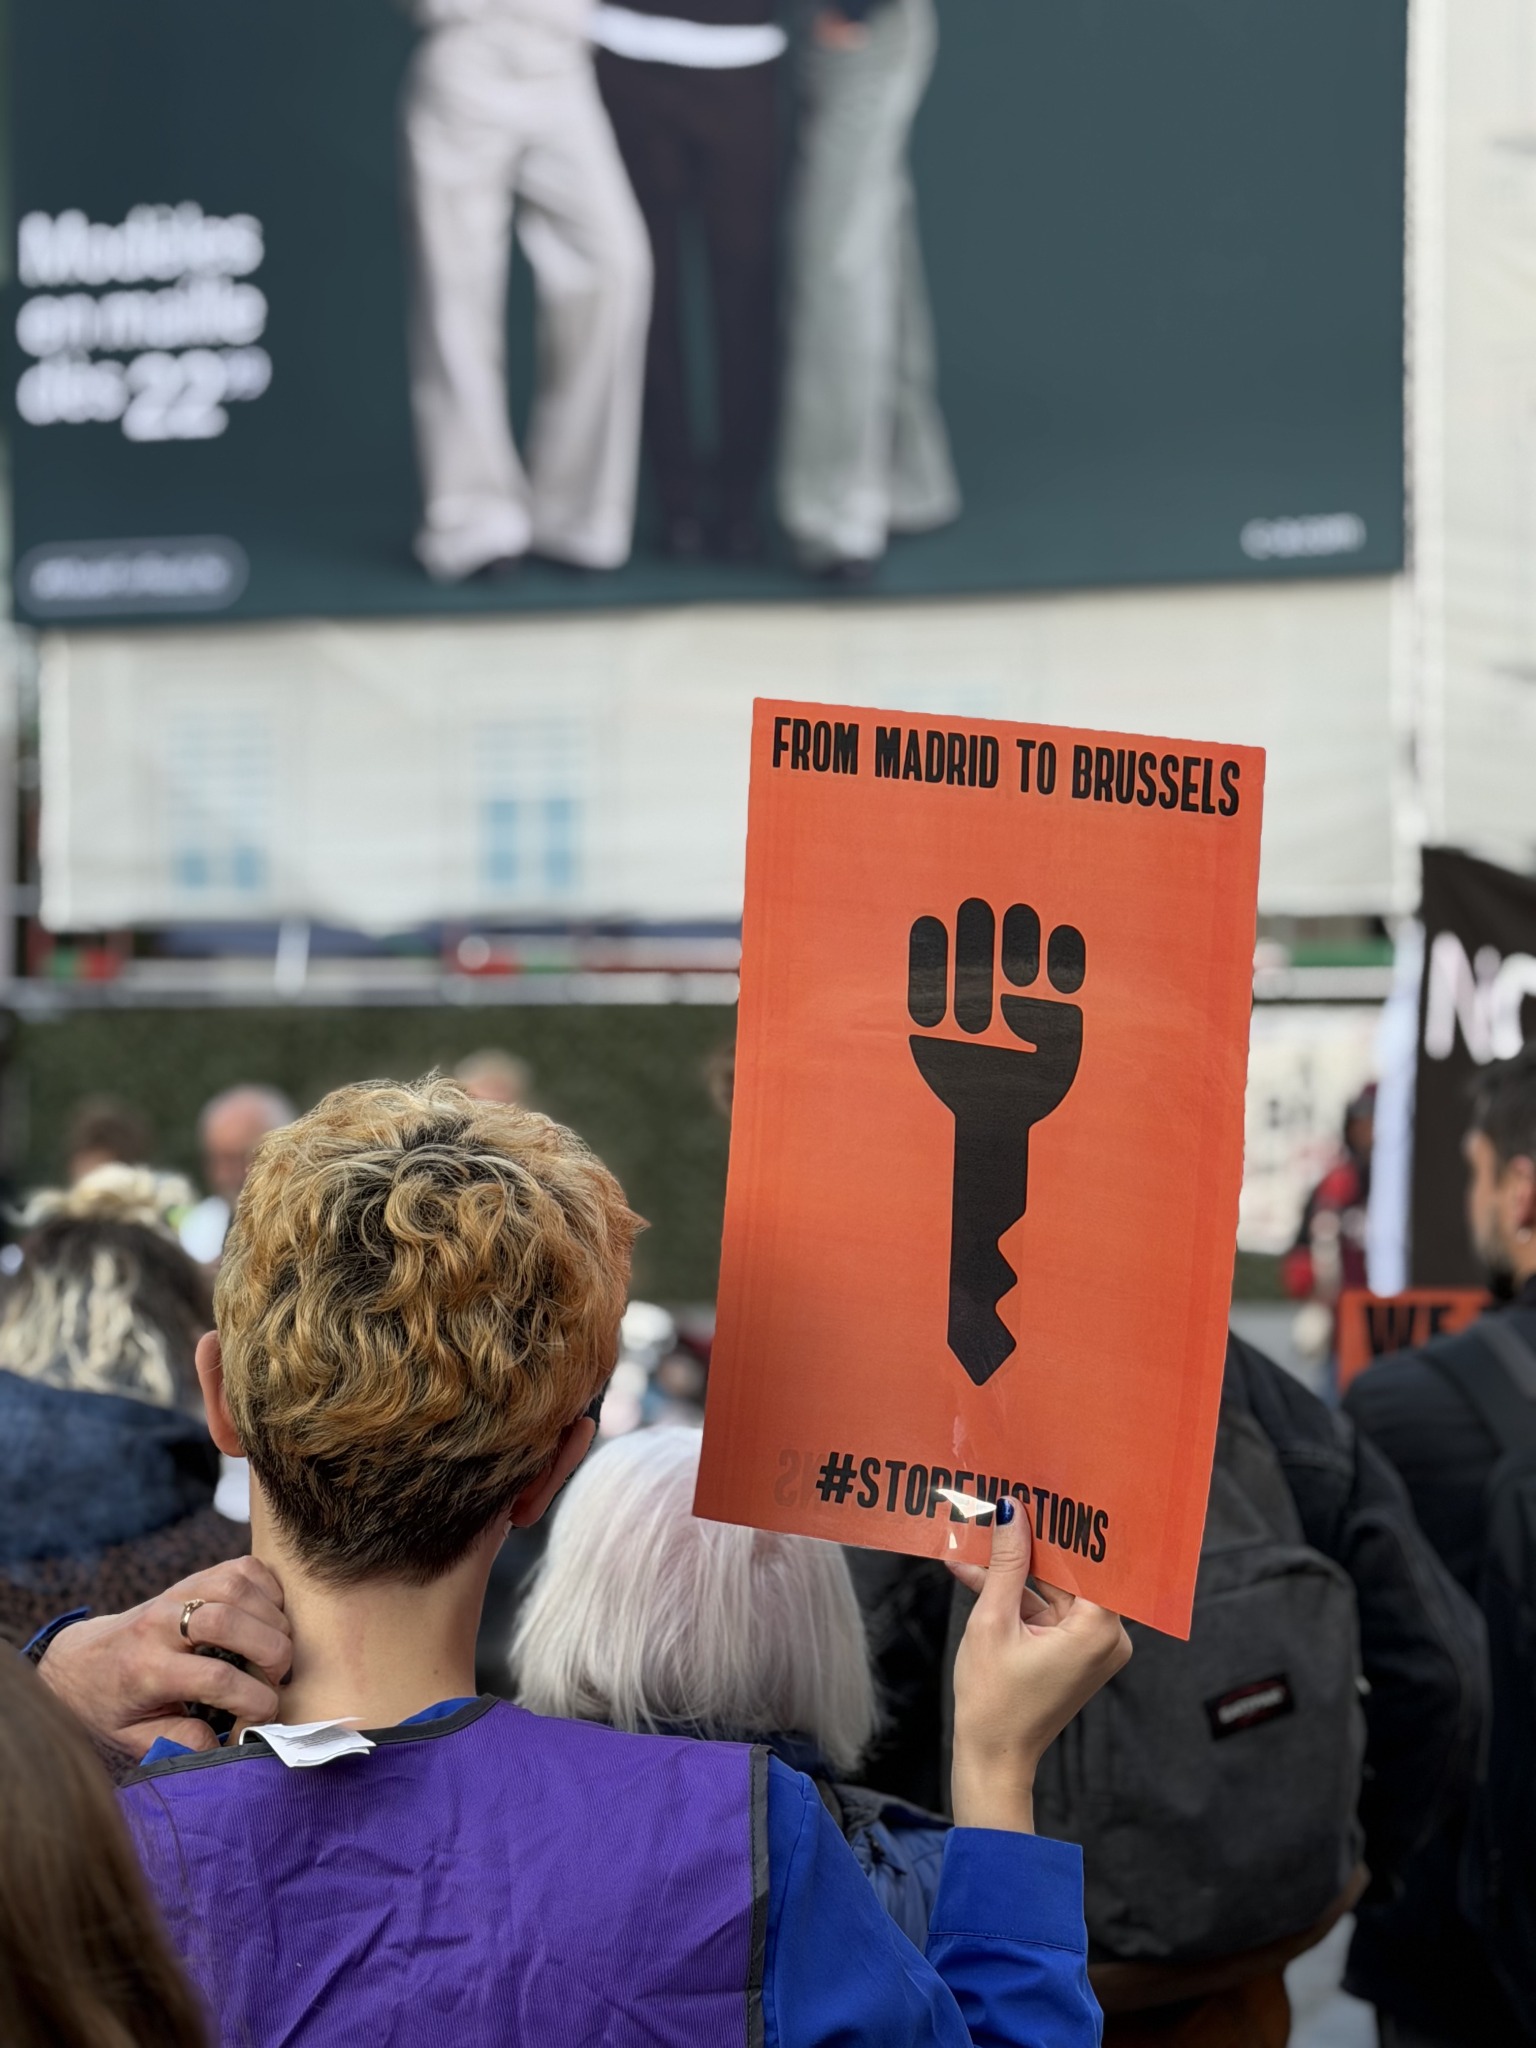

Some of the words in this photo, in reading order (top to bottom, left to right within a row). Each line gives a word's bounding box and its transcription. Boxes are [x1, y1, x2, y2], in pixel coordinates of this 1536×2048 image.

[773, 717, 859, 774] FROM
[875, 727, 998, 788] MADRID
[1017, 739, 1056, 794] TO
[1072, 745, 1240, 816] BRUSSELS
